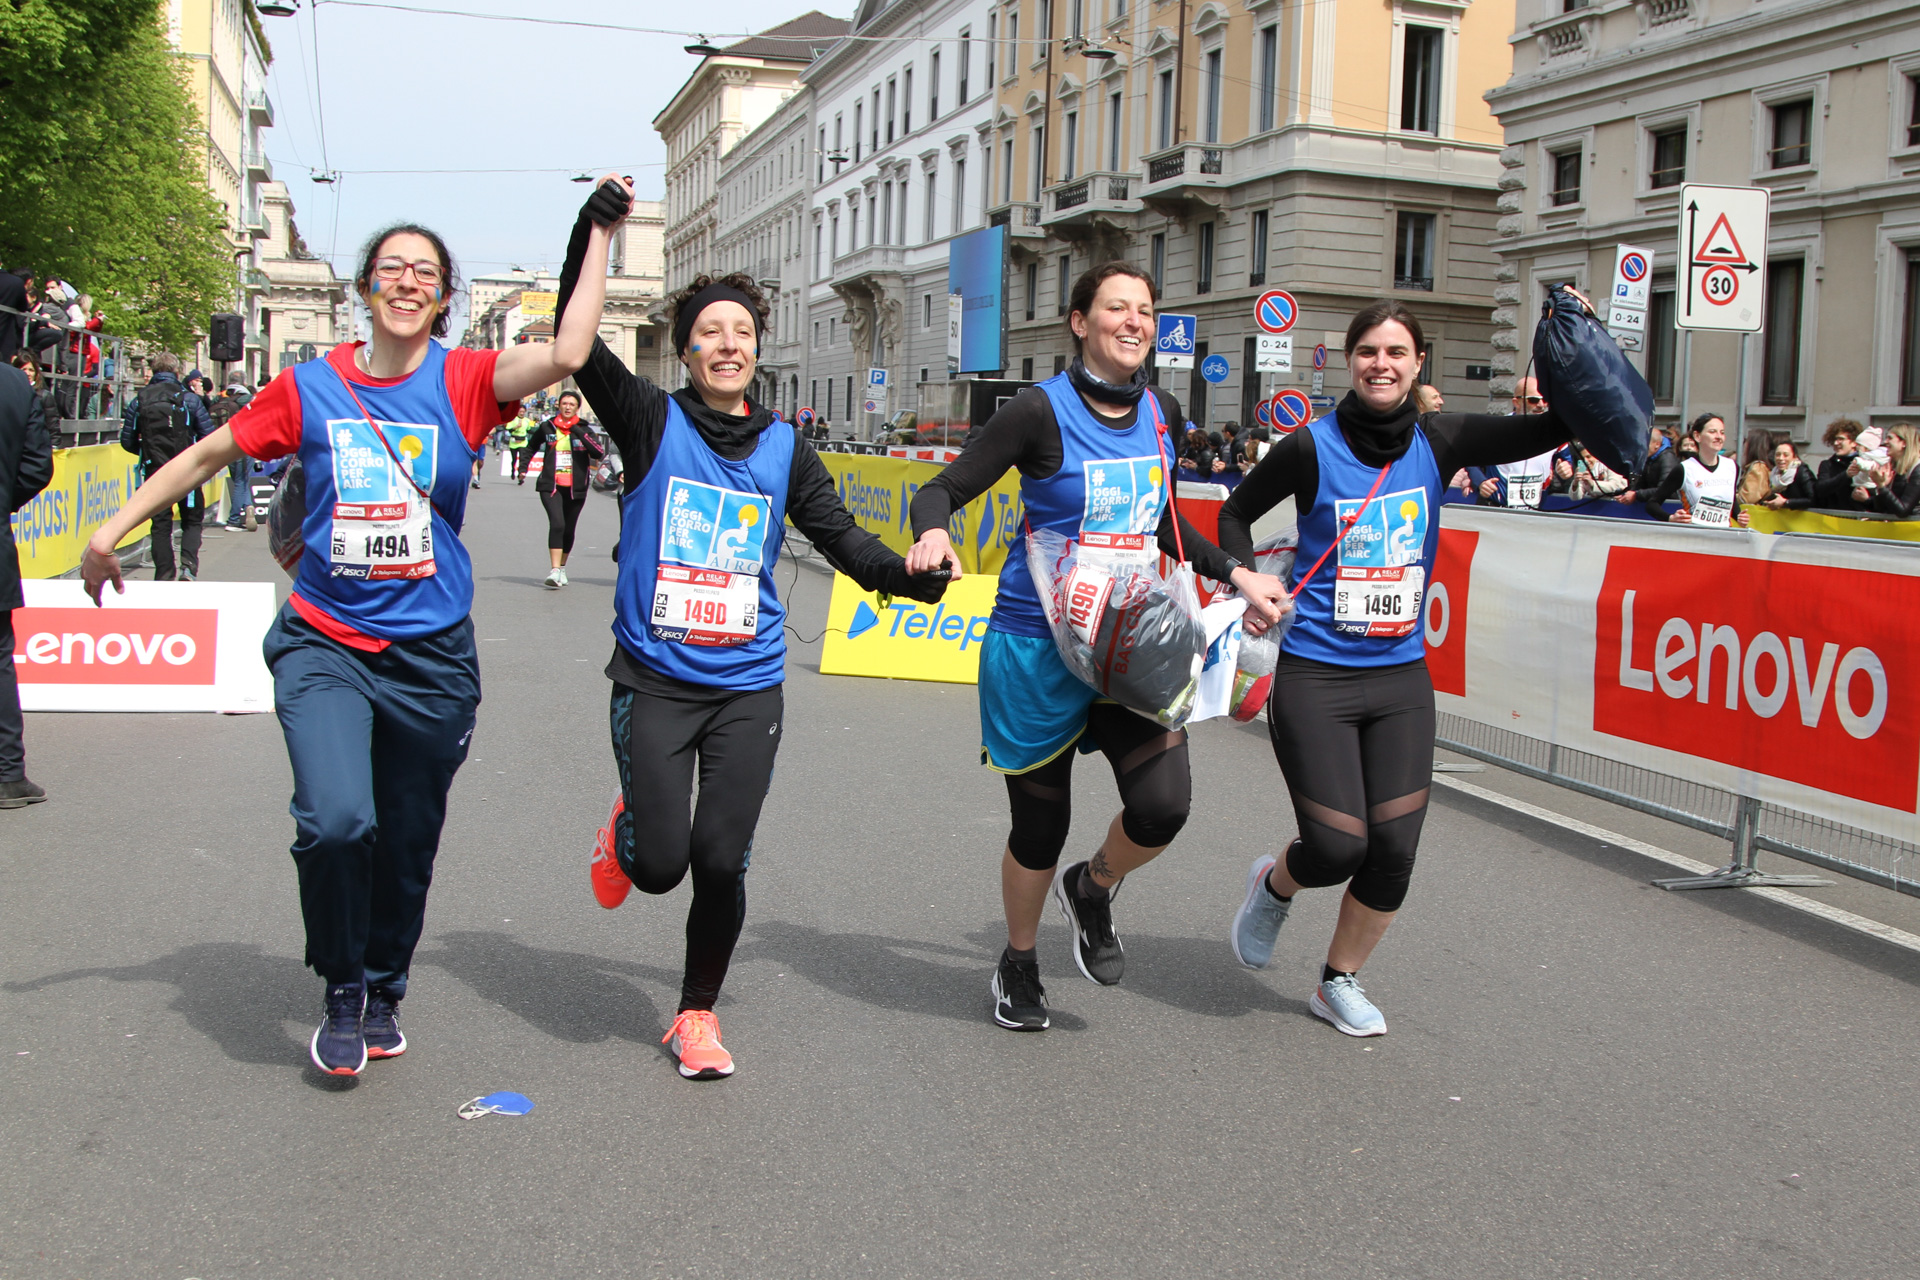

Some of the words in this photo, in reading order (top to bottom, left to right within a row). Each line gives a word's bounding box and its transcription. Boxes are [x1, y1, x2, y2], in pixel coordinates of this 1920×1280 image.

[1618, 286, 1626, 295] P
[1710, 277, 1731, 294] 30
[873, 371, 883, 383] P
[340, 447, 371, 459] OGGI
[340, 457, 384, 469] CORRO
[341, 468, 365, 479] PER
[342, 478, 371, 489] AIRC
[84, 465, 120, 527] Telepass
[1093, 487, 1121, 497] OGGI
[847, 470, 891, 529] Telepass
[1093, 495, 1130, 506] CORRO
[671, 506, 702, 521] OGGI
[1092, 505, 1112, 514] PER
[1700, 510, 1723, 523] 6004
[10, 487, 68, 558] elepass
[1089, 513, 1115, 522] AIRC
[669, 525, 689, 539] PER
[670, 517, 711, 533] CORRO
[667, 535, 694, 549] AIRC
[1344, 532, 1382, 543] CORRO
[365, 534, 410, 557] 149A
[1344, 542, 1365, 551] PER
[1344, 550, 1371, 559] AIRC
[1388, 552, 1420, 565] AIR
[709, 556, 759, 574] AIRC
[684, 599, 727, 625] 149D
[1070, 581, 1099, 629] 149B
[1364, 594, 1402, 616] 149C
[889, 603, 990, 651] Telep
[1114, 635, 1136, 675] BAG
[1619, 589, 1888, 740] Lenovo
